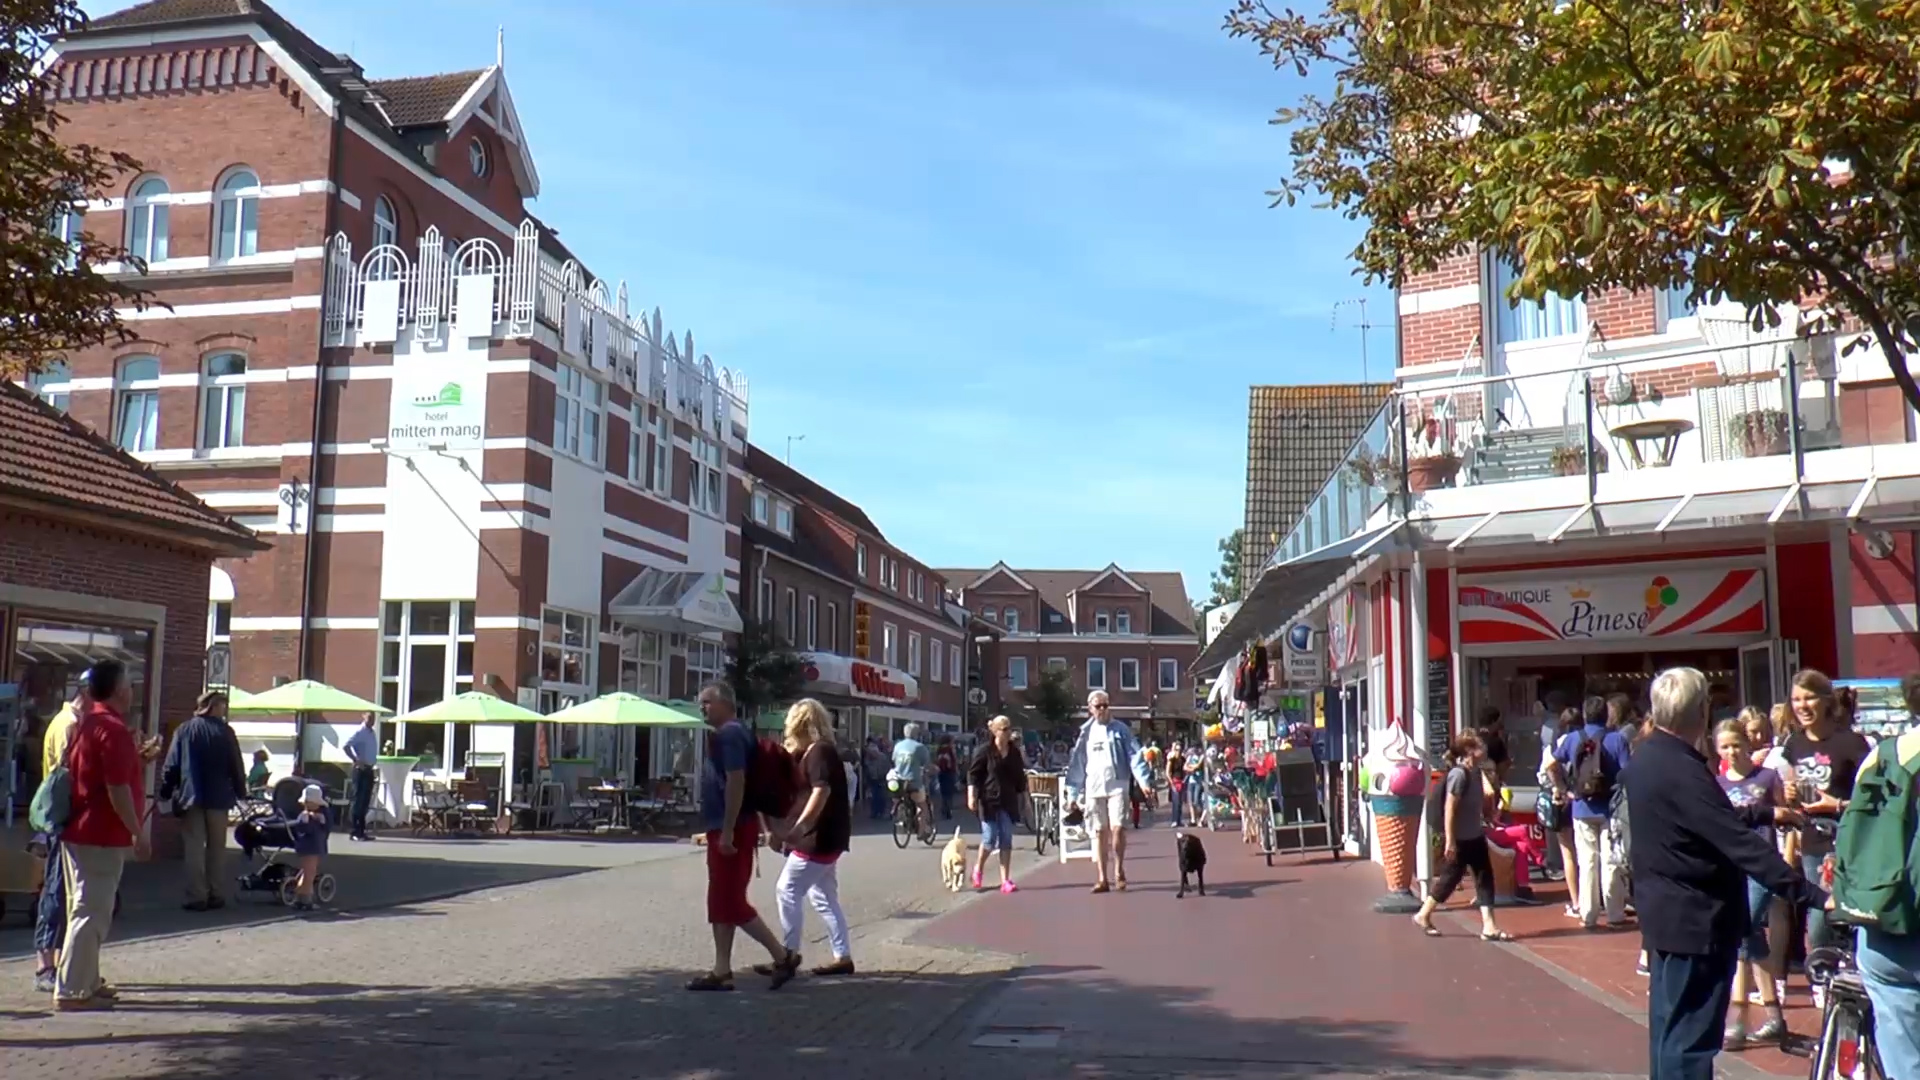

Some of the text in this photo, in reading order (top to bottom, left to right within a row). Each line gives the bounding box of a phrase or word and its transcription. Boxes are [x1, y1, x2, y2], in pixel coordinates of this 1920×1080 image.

[425, 411, 448, 421] hotel
[391, 424, 481, 440] mitten mang
